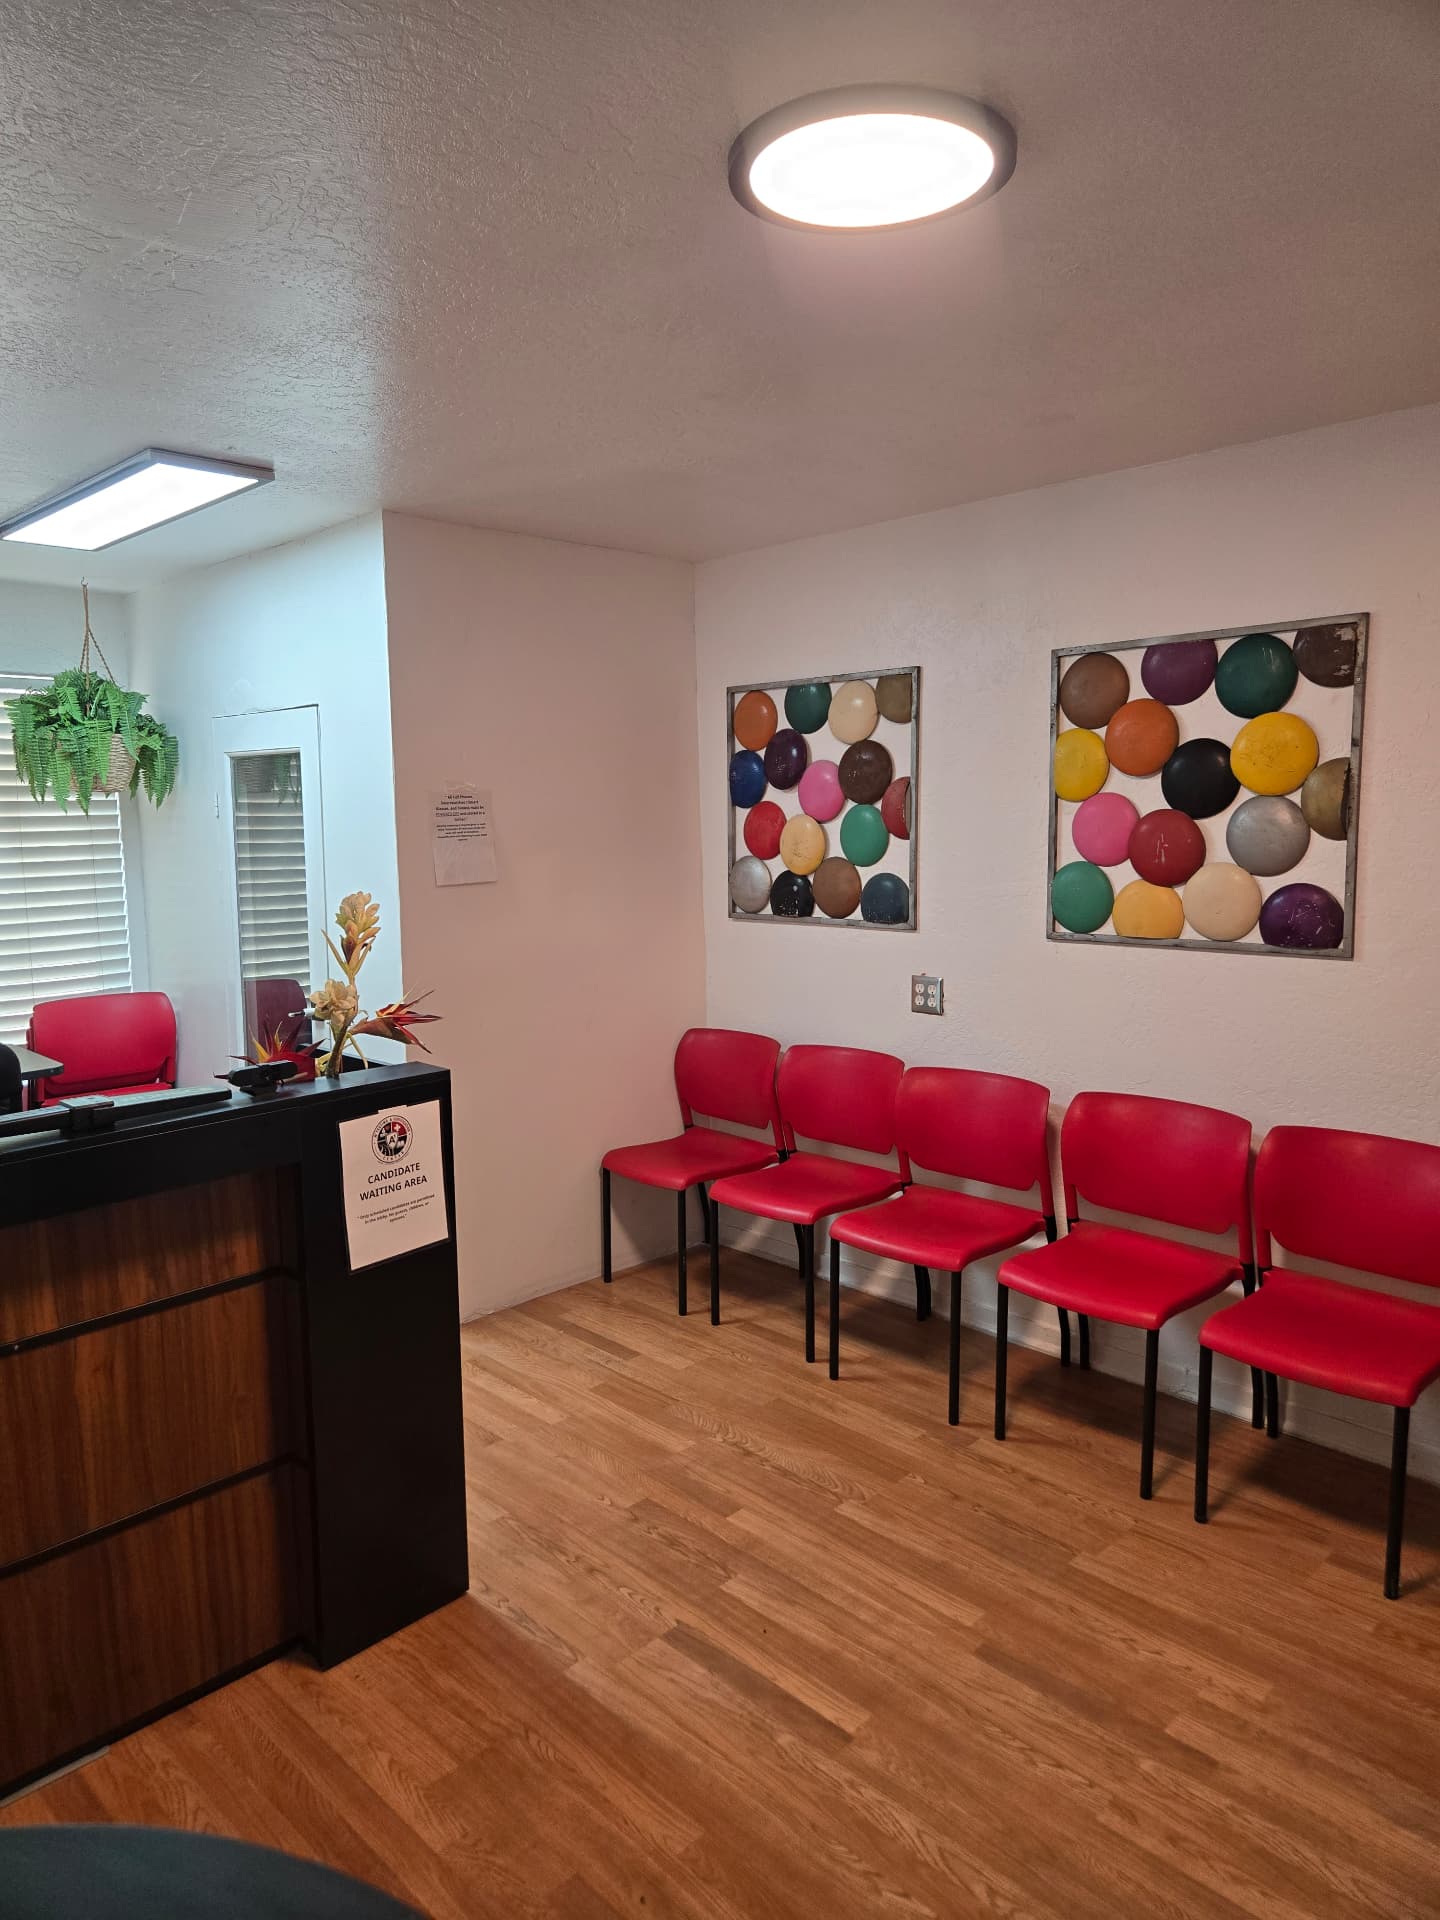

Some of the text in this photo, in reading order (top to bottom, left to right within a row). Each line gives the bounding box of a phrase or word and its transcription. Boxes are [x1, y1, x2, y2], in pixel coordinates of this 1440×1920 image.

[367, 1162, 421, 1184] CANDIDATE
[359, 1175, 428, 1201] WAITING AREA
